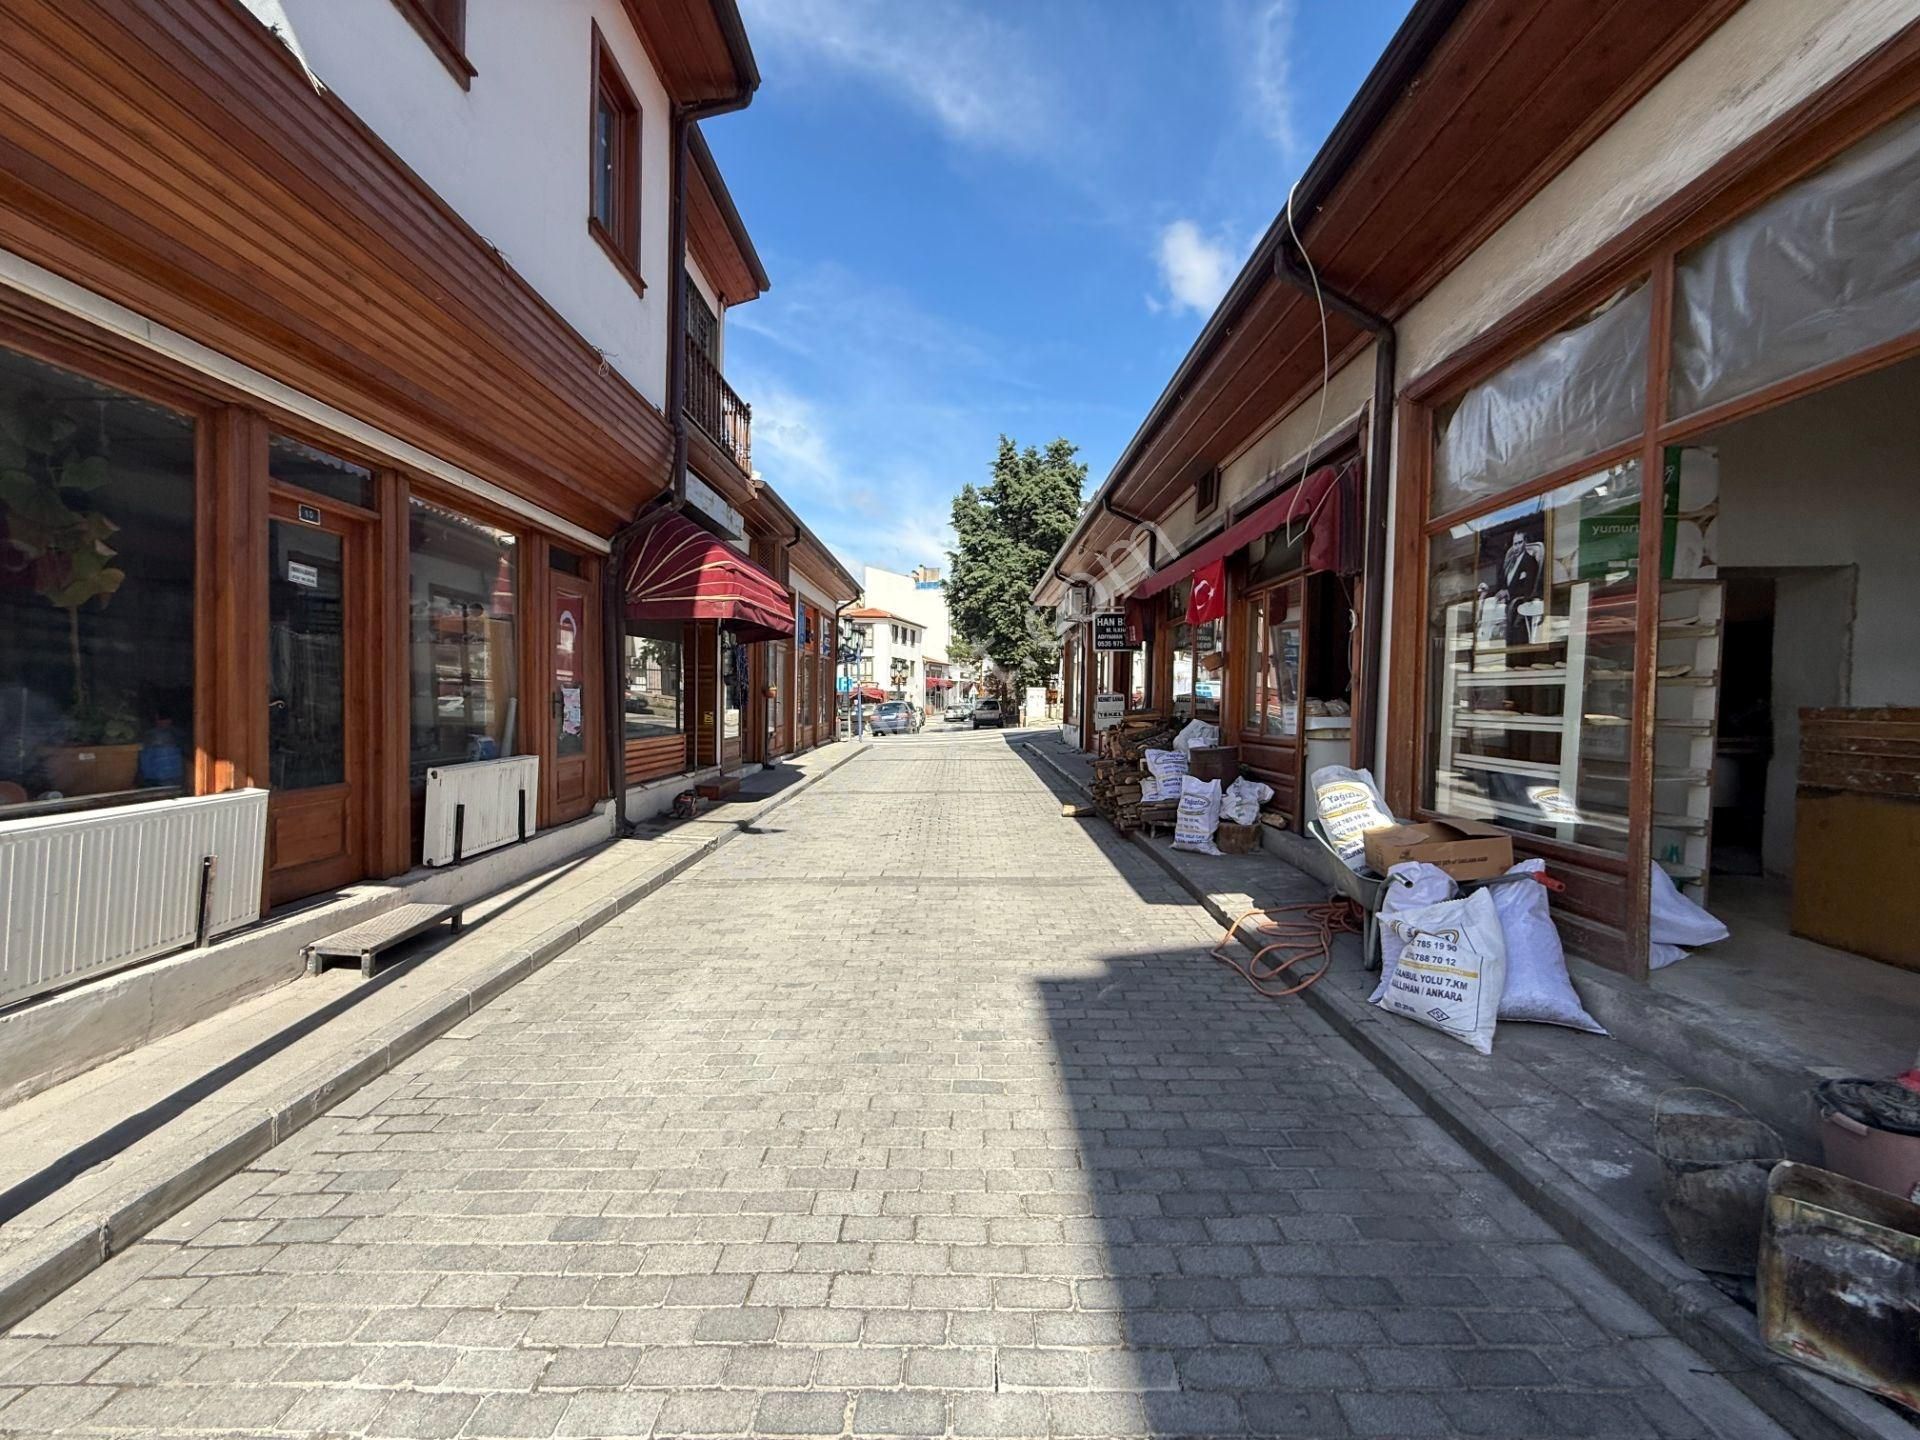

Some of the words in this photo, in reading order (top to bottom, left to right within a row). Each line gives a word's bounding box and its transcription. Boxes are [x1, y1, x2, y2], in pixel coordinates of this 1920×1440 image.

[1591, 524, 1640, 536] yumurt
[1097, 617, 1115, 627] HAN
[1416, 939, 1432, 949] 785
[1434, 941, 1445, 950] 19
[1447, 943, 1458, 953] 90
[1415, 953, 1430, 963] 788
[1432, 955, 1443, 964] 70
[1446, 957, 1456, 967] 12
[1420, 974, 1443, 986] YOLU
[1445, 978, 1469, 991] 7.KM
[1426, 987, 1463, 1002] ANKARA
